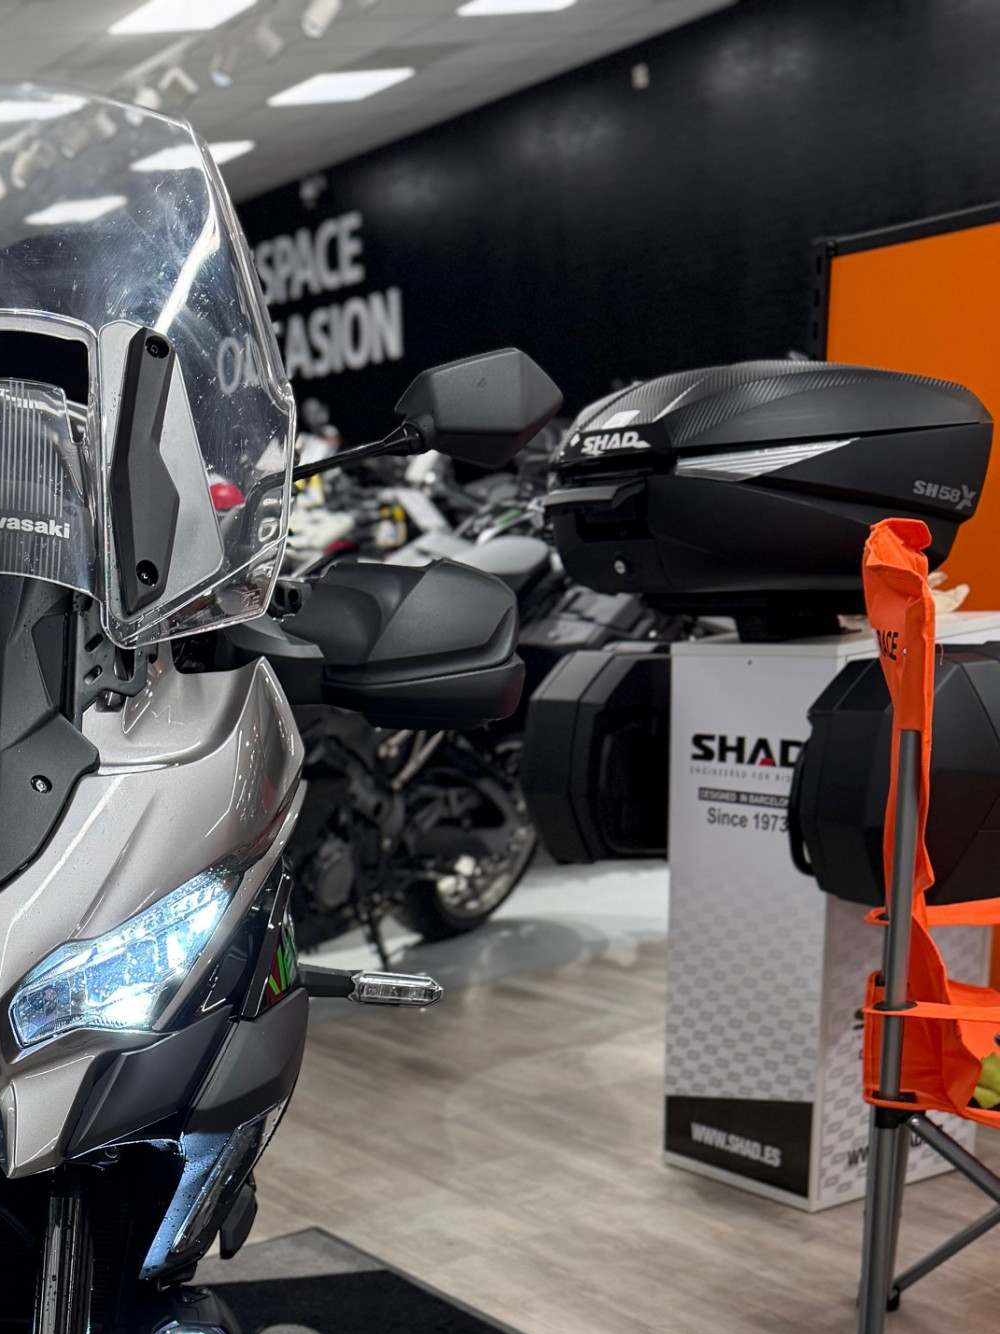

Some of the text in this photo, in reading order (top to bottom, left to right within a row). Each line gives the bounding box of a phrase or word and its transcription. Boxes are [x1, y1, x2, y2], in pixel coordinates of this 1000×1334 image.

[252, 211, 366, 306] SPACE
[217, 286, 404, 396] OASION
[580, 430, 652, 456] SHAD
[690, 733, 805, 768] SHAD
[706, 806, 790, 834] Since 1973
[690, 1121, 782, 1169] WWW.SHAD.ES
